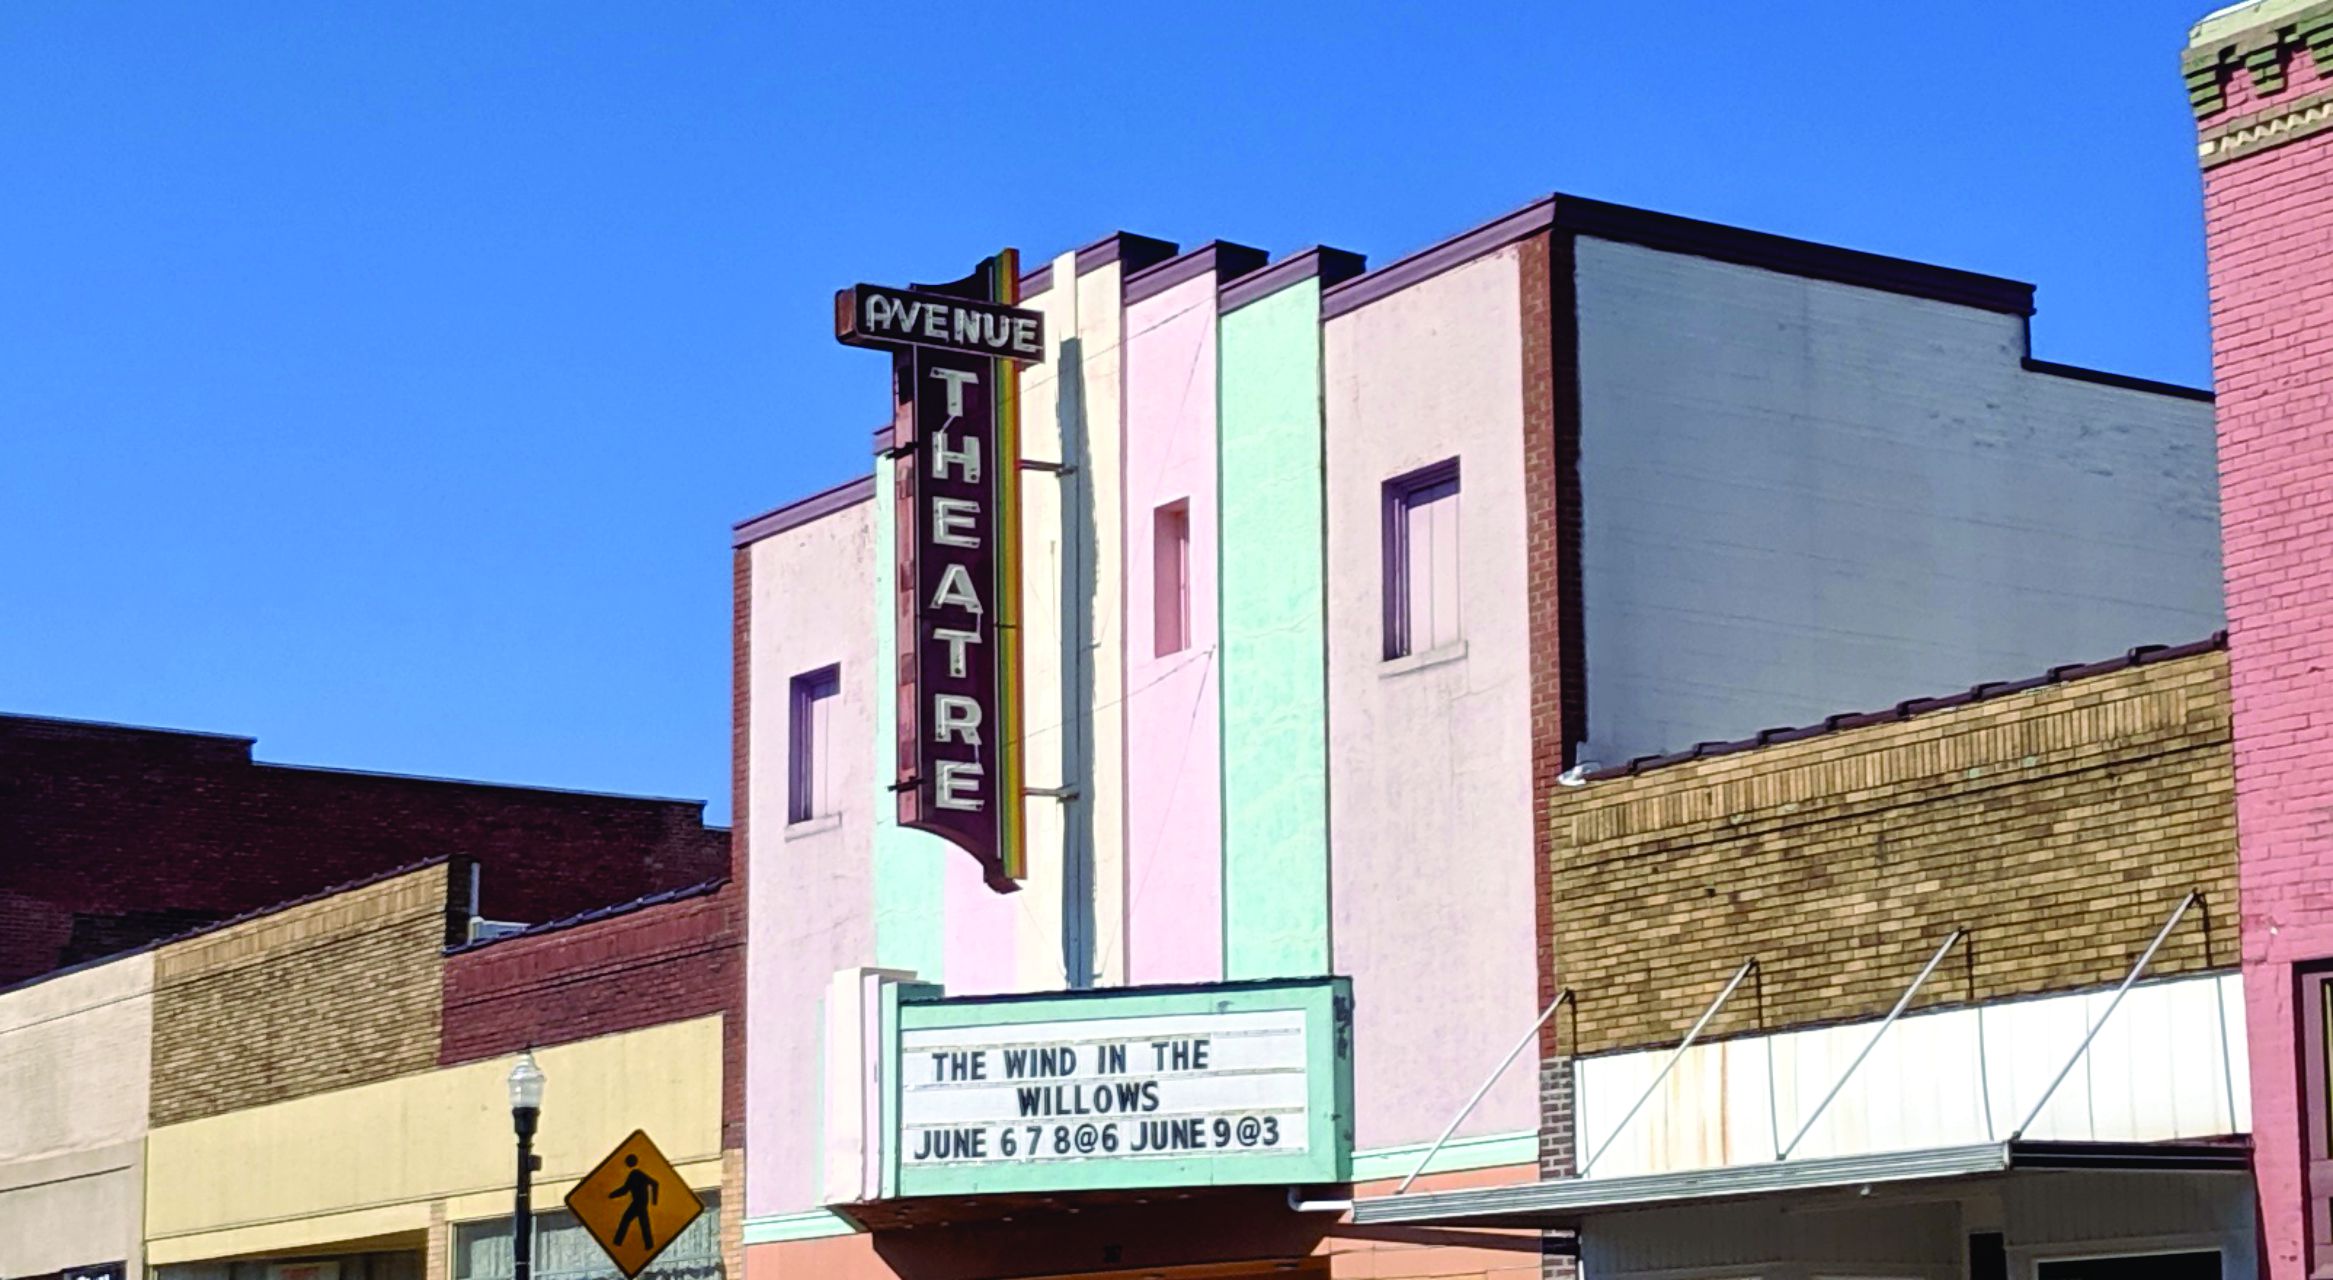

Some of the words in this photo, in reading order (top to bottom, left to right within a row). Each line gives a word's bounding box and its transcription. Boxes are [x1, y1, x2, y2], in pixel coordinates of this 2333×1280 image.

[866, 294, 1042, 352] AVENUE
[929, 367, 985, 811] THEATRE
[932, 1051, 986, 1081] THE
[1004, 1047, 1077, 1079] WIND
[1098, 1044, 1126, 1074] IN
[1152, 1039, 1210, 1071] THE
[1017, 1080, 1159, 1117] WILLOWS
[914, 1128, 987, 1160] JUNE
[1130, 1118, 1207, 1151] JUNE
